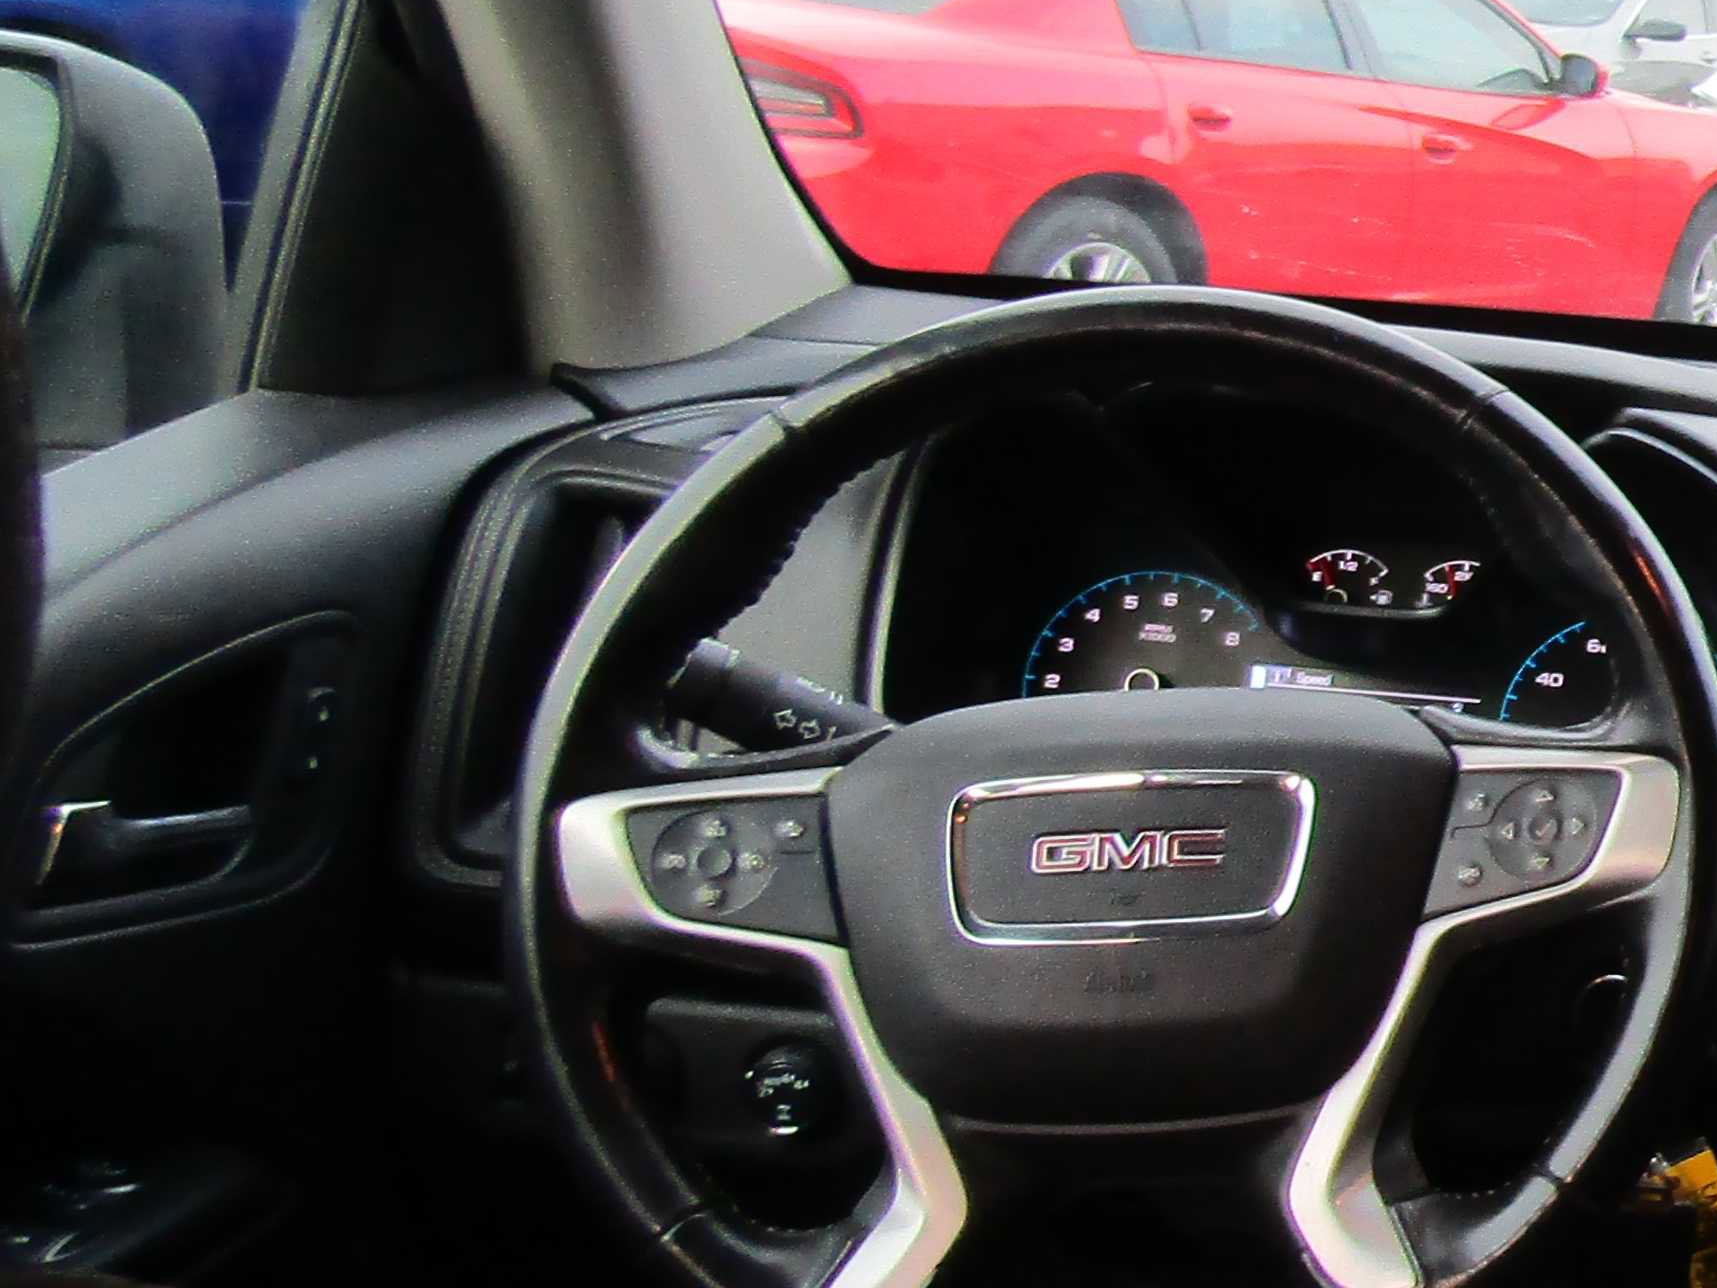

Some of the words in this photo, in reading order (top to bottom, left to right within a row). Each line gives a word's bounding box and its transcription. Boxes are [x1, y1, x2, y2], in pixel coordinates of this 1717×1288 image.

[1122, 594, 1139, 611] 5
[1163, 592, 1179, 608] 6
[1084, 608, 1101, 623] 4
[1200, 608, 1215, 623] 7
[1058, 637, 1075, 653] 3
[1224, 631, 1240, 647] 8
[1586, 639, 1607, 654] 6
[1043, 673, 1061, 689] 2
[1535, 672, 1564, 687] 40
[1030, 827, 1228, 874] GMC
